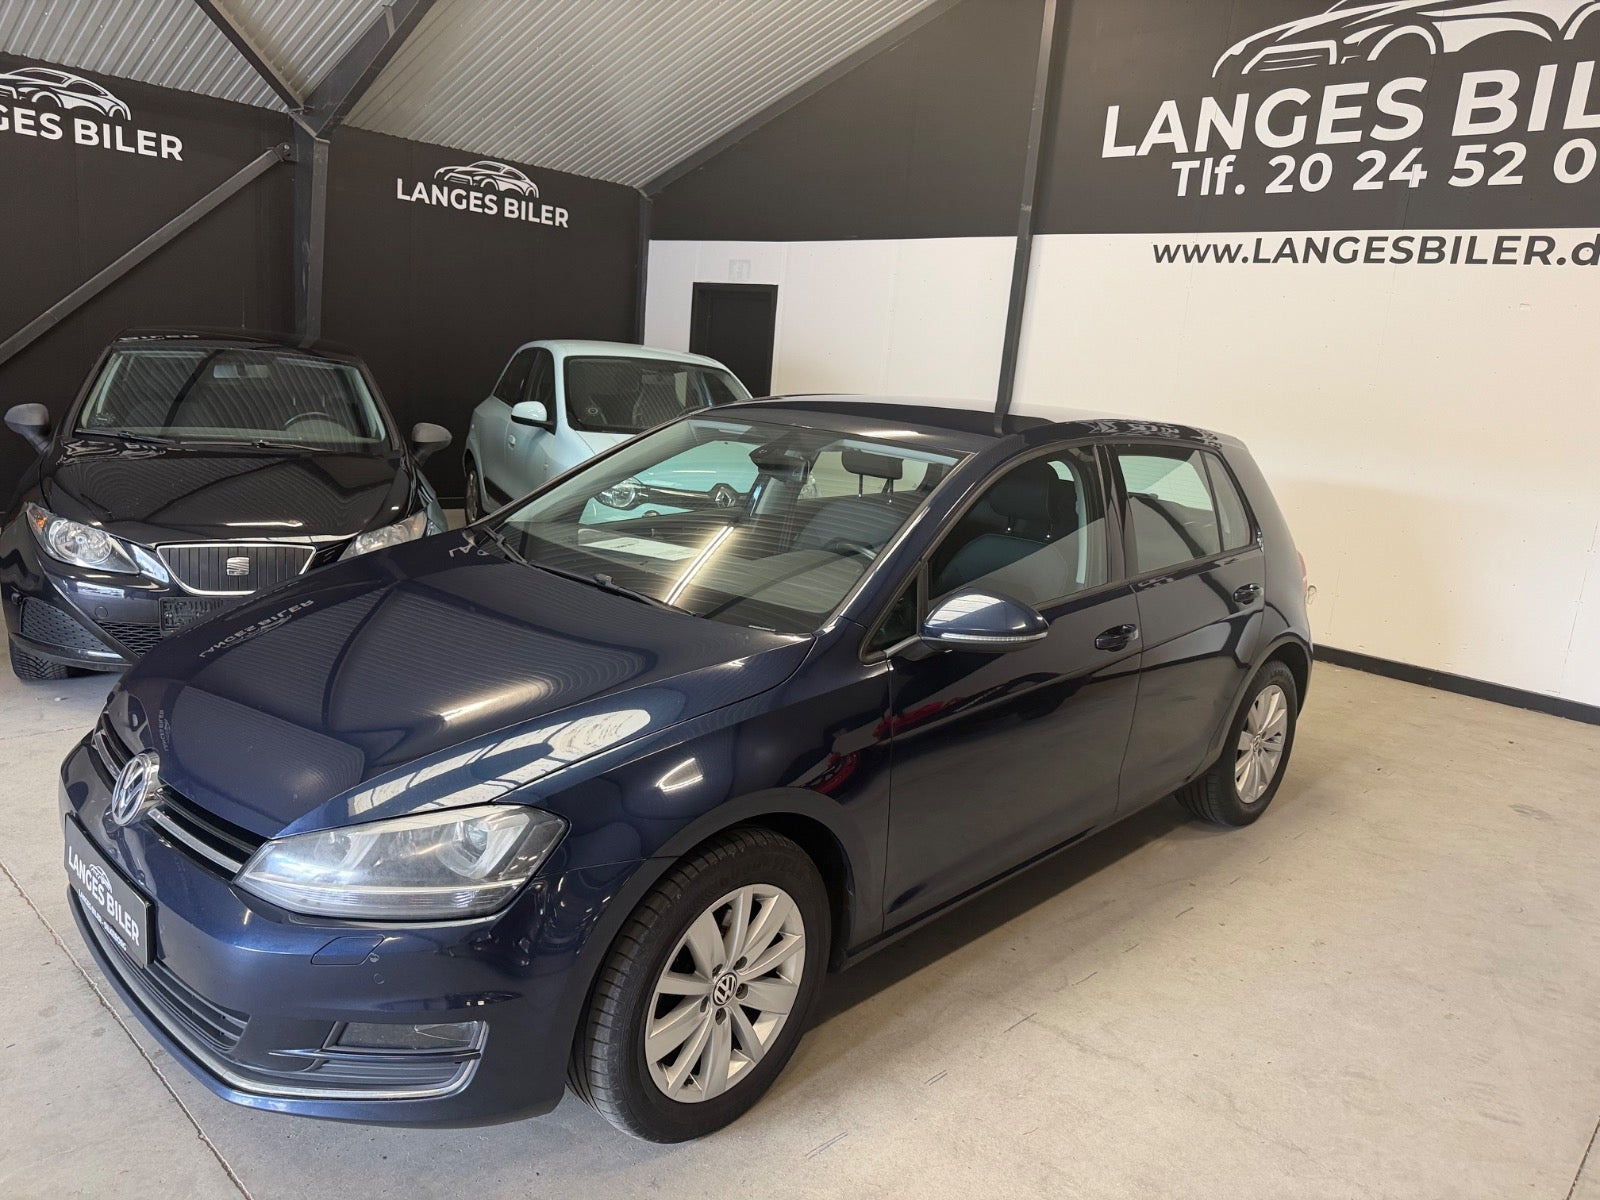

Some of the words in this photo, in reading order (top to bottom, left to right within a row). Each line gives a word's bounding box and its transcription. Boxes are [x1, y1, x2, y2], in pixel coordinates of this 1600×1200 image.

[1102, 77, 1428, 158] LANGES
[1451, 60, 1600, 137] BIL
[73, 117, 184, 162] BILER
[1171, 154, 1246, 197] Tlf.
[1265, 152, 1333, 194] 20
[1352, 147, 1428, 191] 24
[1448, 141, 1527, 187] 52
[1553, 137, 1597, 184] 0
[396, 177, 498, 215] LANGES
[503, 197, 569, 228] BILER
[1152, 233, 1600, 266] www.LANGESBILER.d
[68, 845, 105, 906] LANGES
[106, 891, 140, 946] BILER
